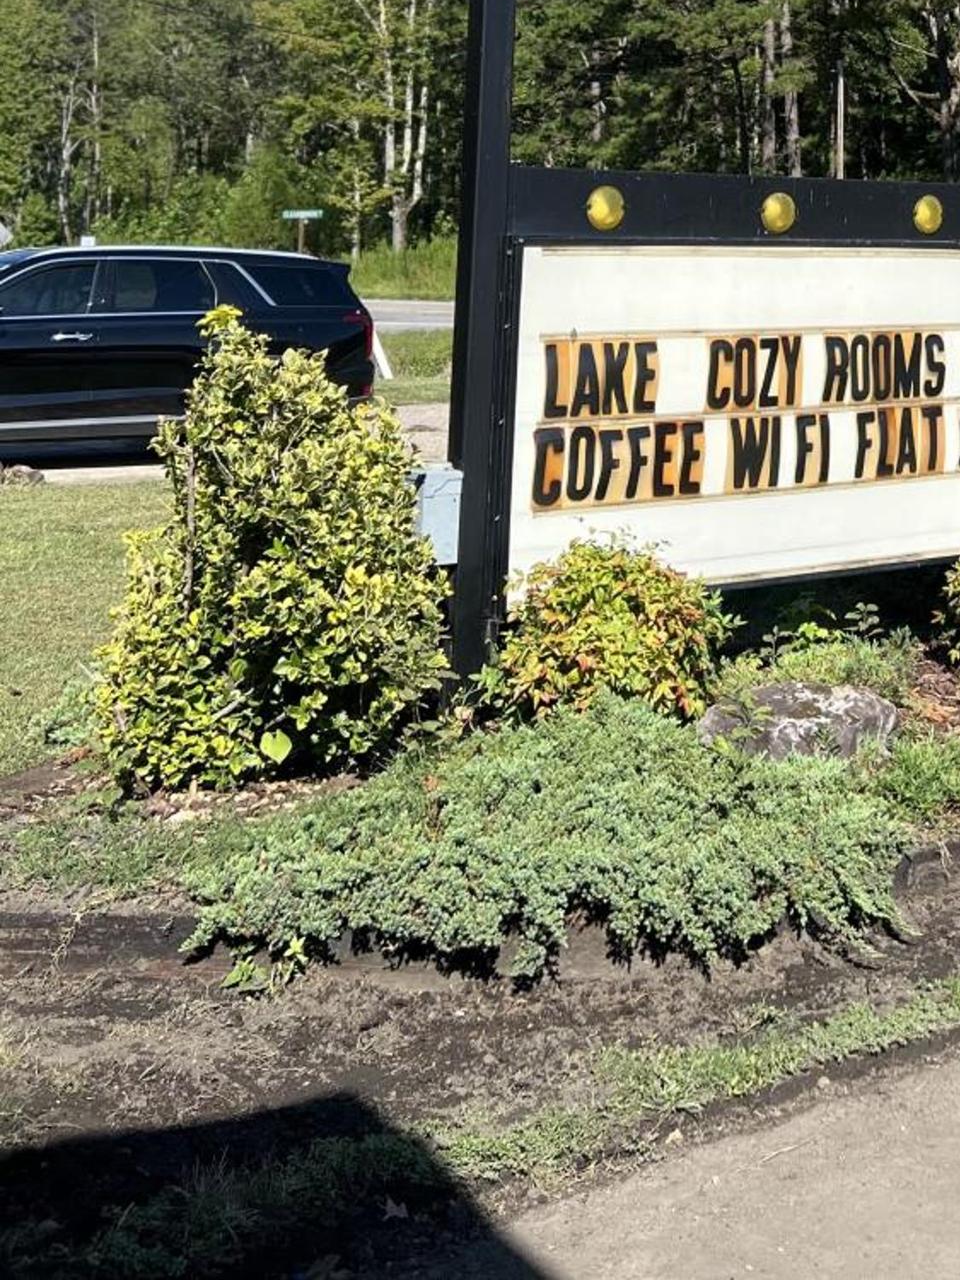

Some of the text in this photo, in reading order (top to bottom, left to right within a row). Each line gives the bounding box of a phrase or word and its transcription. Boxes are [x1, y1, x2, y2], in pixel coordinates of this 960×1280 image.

[543, 341, 660, 419] LAKE
[706, 335, 803, 410] COZY
[821, 331, 946, 403] ROOMS
[532, 422, 704, 507] COFFEE
[854, 407, 945, 480] FLAT
